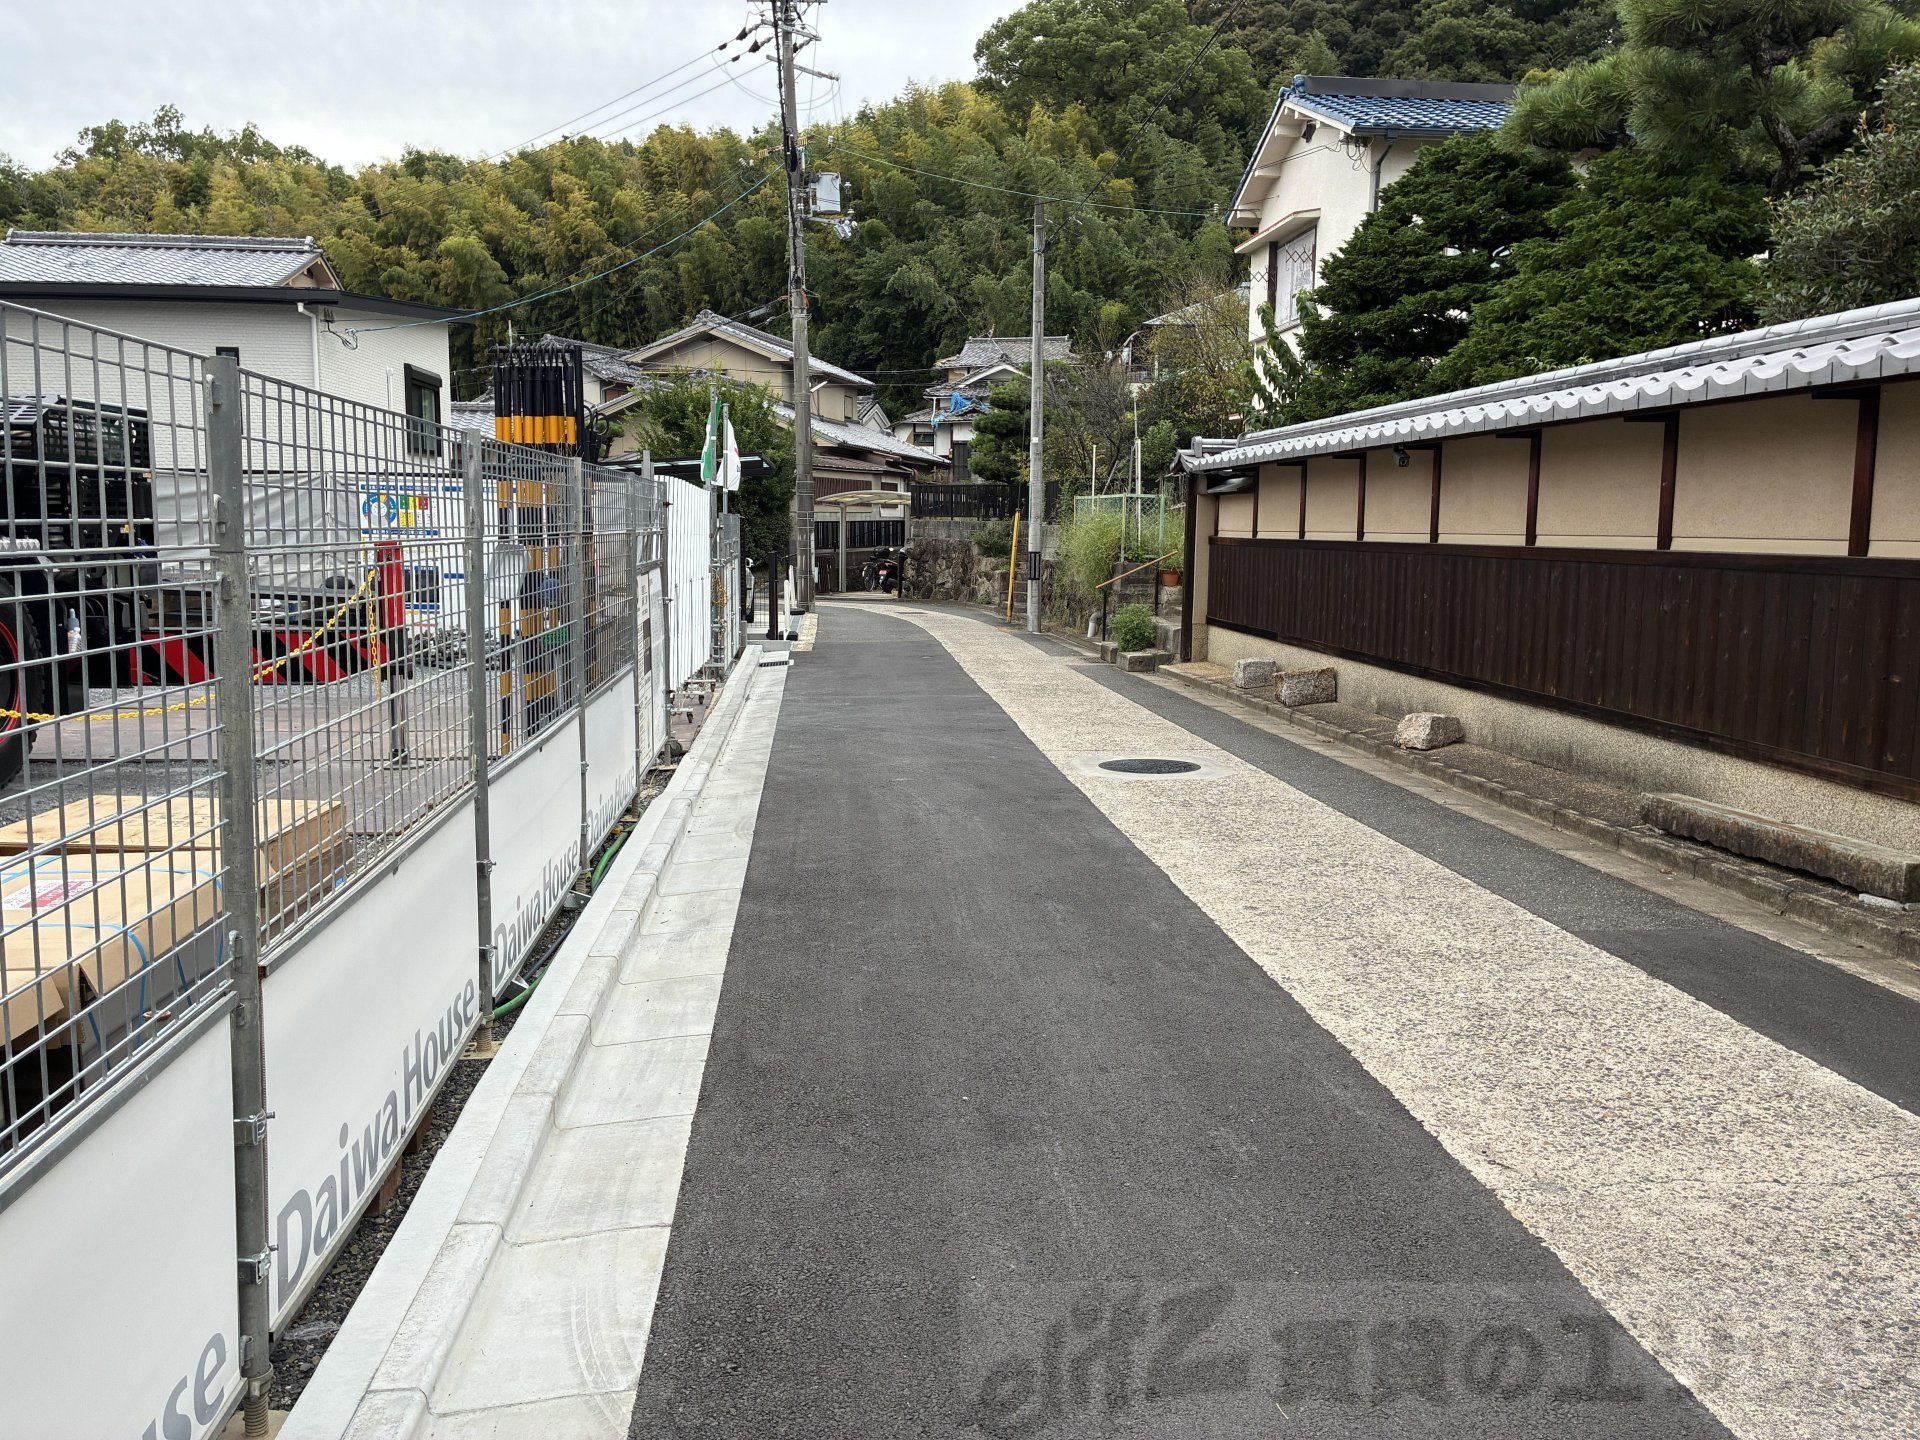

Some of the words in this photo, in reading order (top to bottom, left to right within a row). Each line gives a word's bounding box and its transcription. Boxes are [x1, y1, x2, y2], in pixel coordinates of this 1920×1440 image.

[494, 890, 541, 990] Daiwa
[543, 839, 578, 916] House
[277, 1089, 399, 1311] Daiwa
[402, 978, 475, 1122] House
